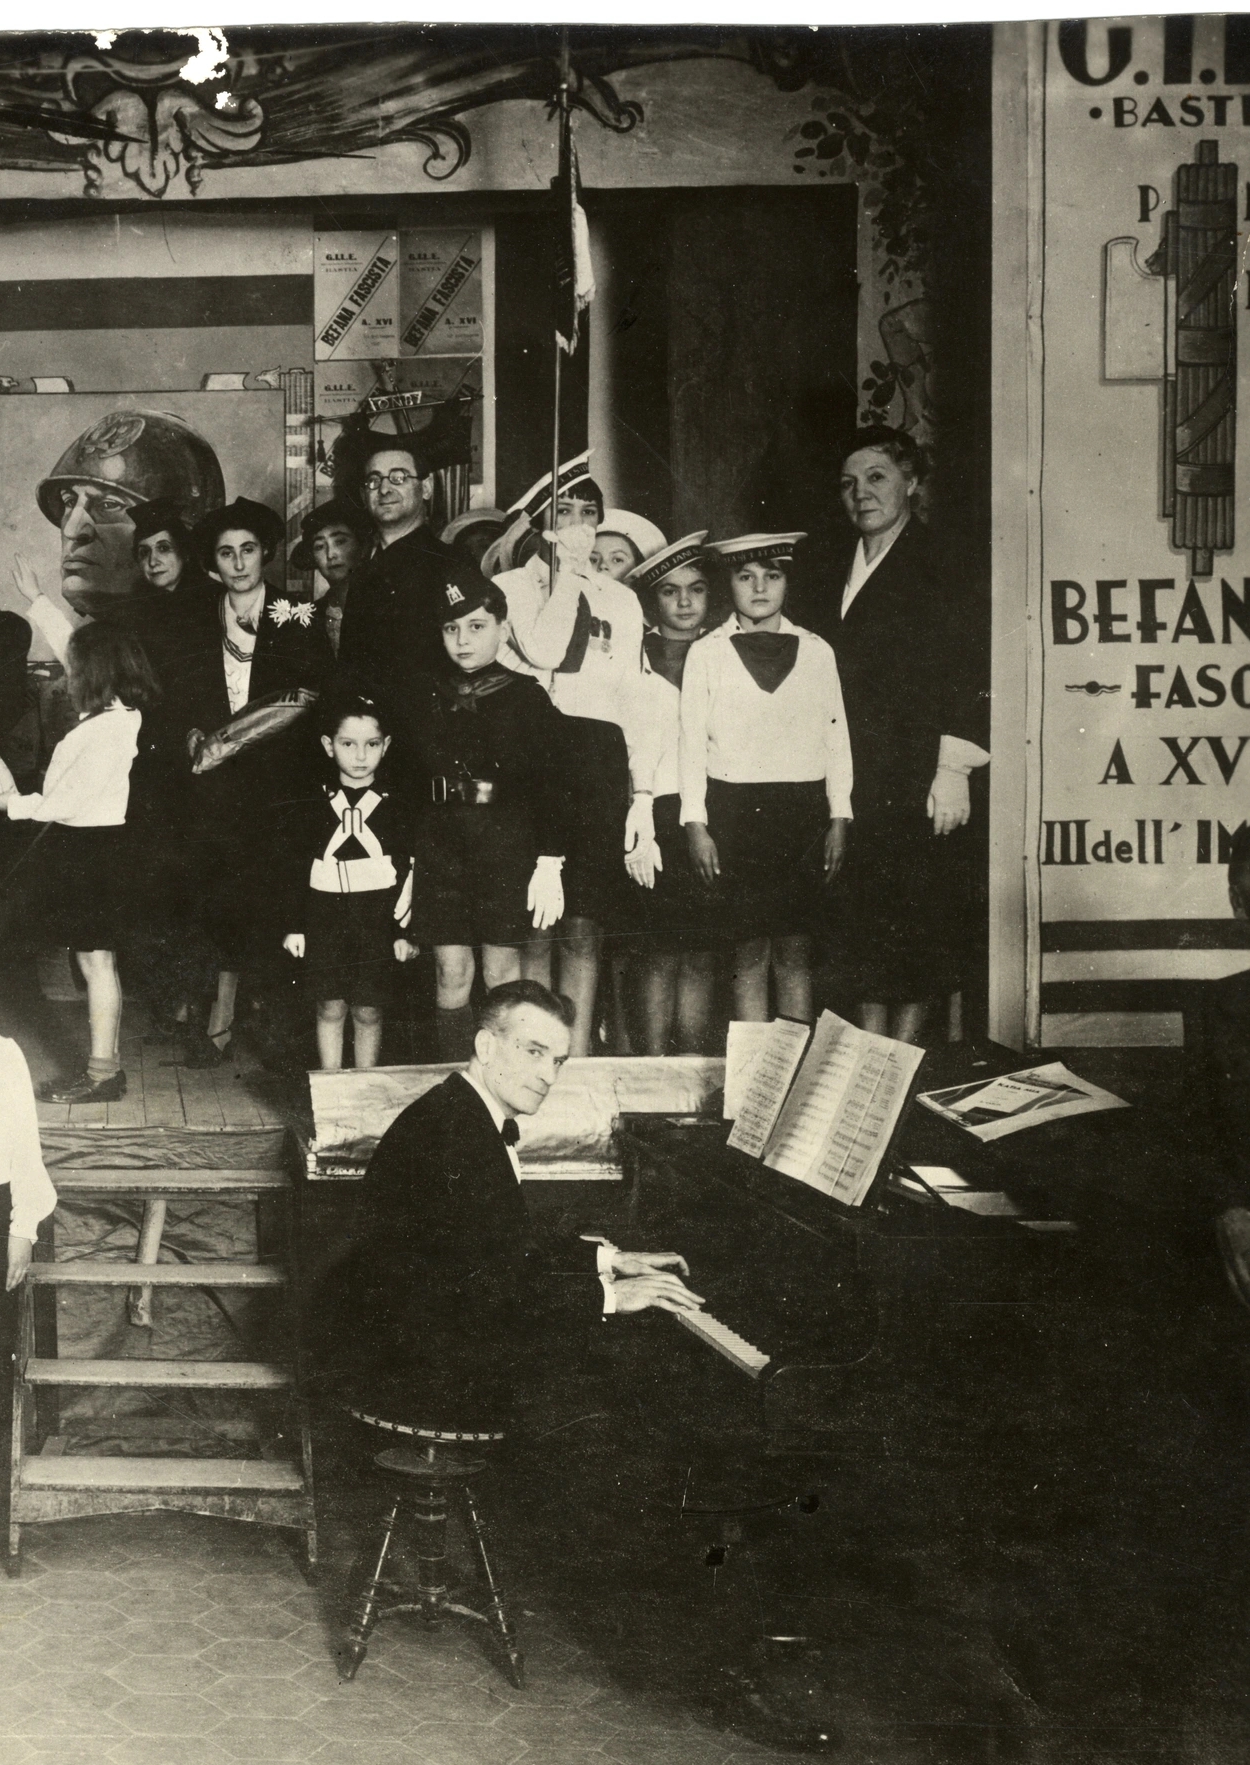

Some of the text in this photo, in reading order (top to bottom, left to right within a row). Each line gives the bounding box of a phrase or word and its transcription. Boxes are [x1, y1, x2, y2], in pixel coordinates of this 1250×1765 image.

[321, 307, 356, 348] BEFANA
[349, 256, 391, 308] FASCISTA
[403, 306, 439, 348] BEFANA
[432, 255, 475, 307] FASCISTA
[1051, 577, 1250, 645] BEFAN
[1098, 738, 1135, 785] A
